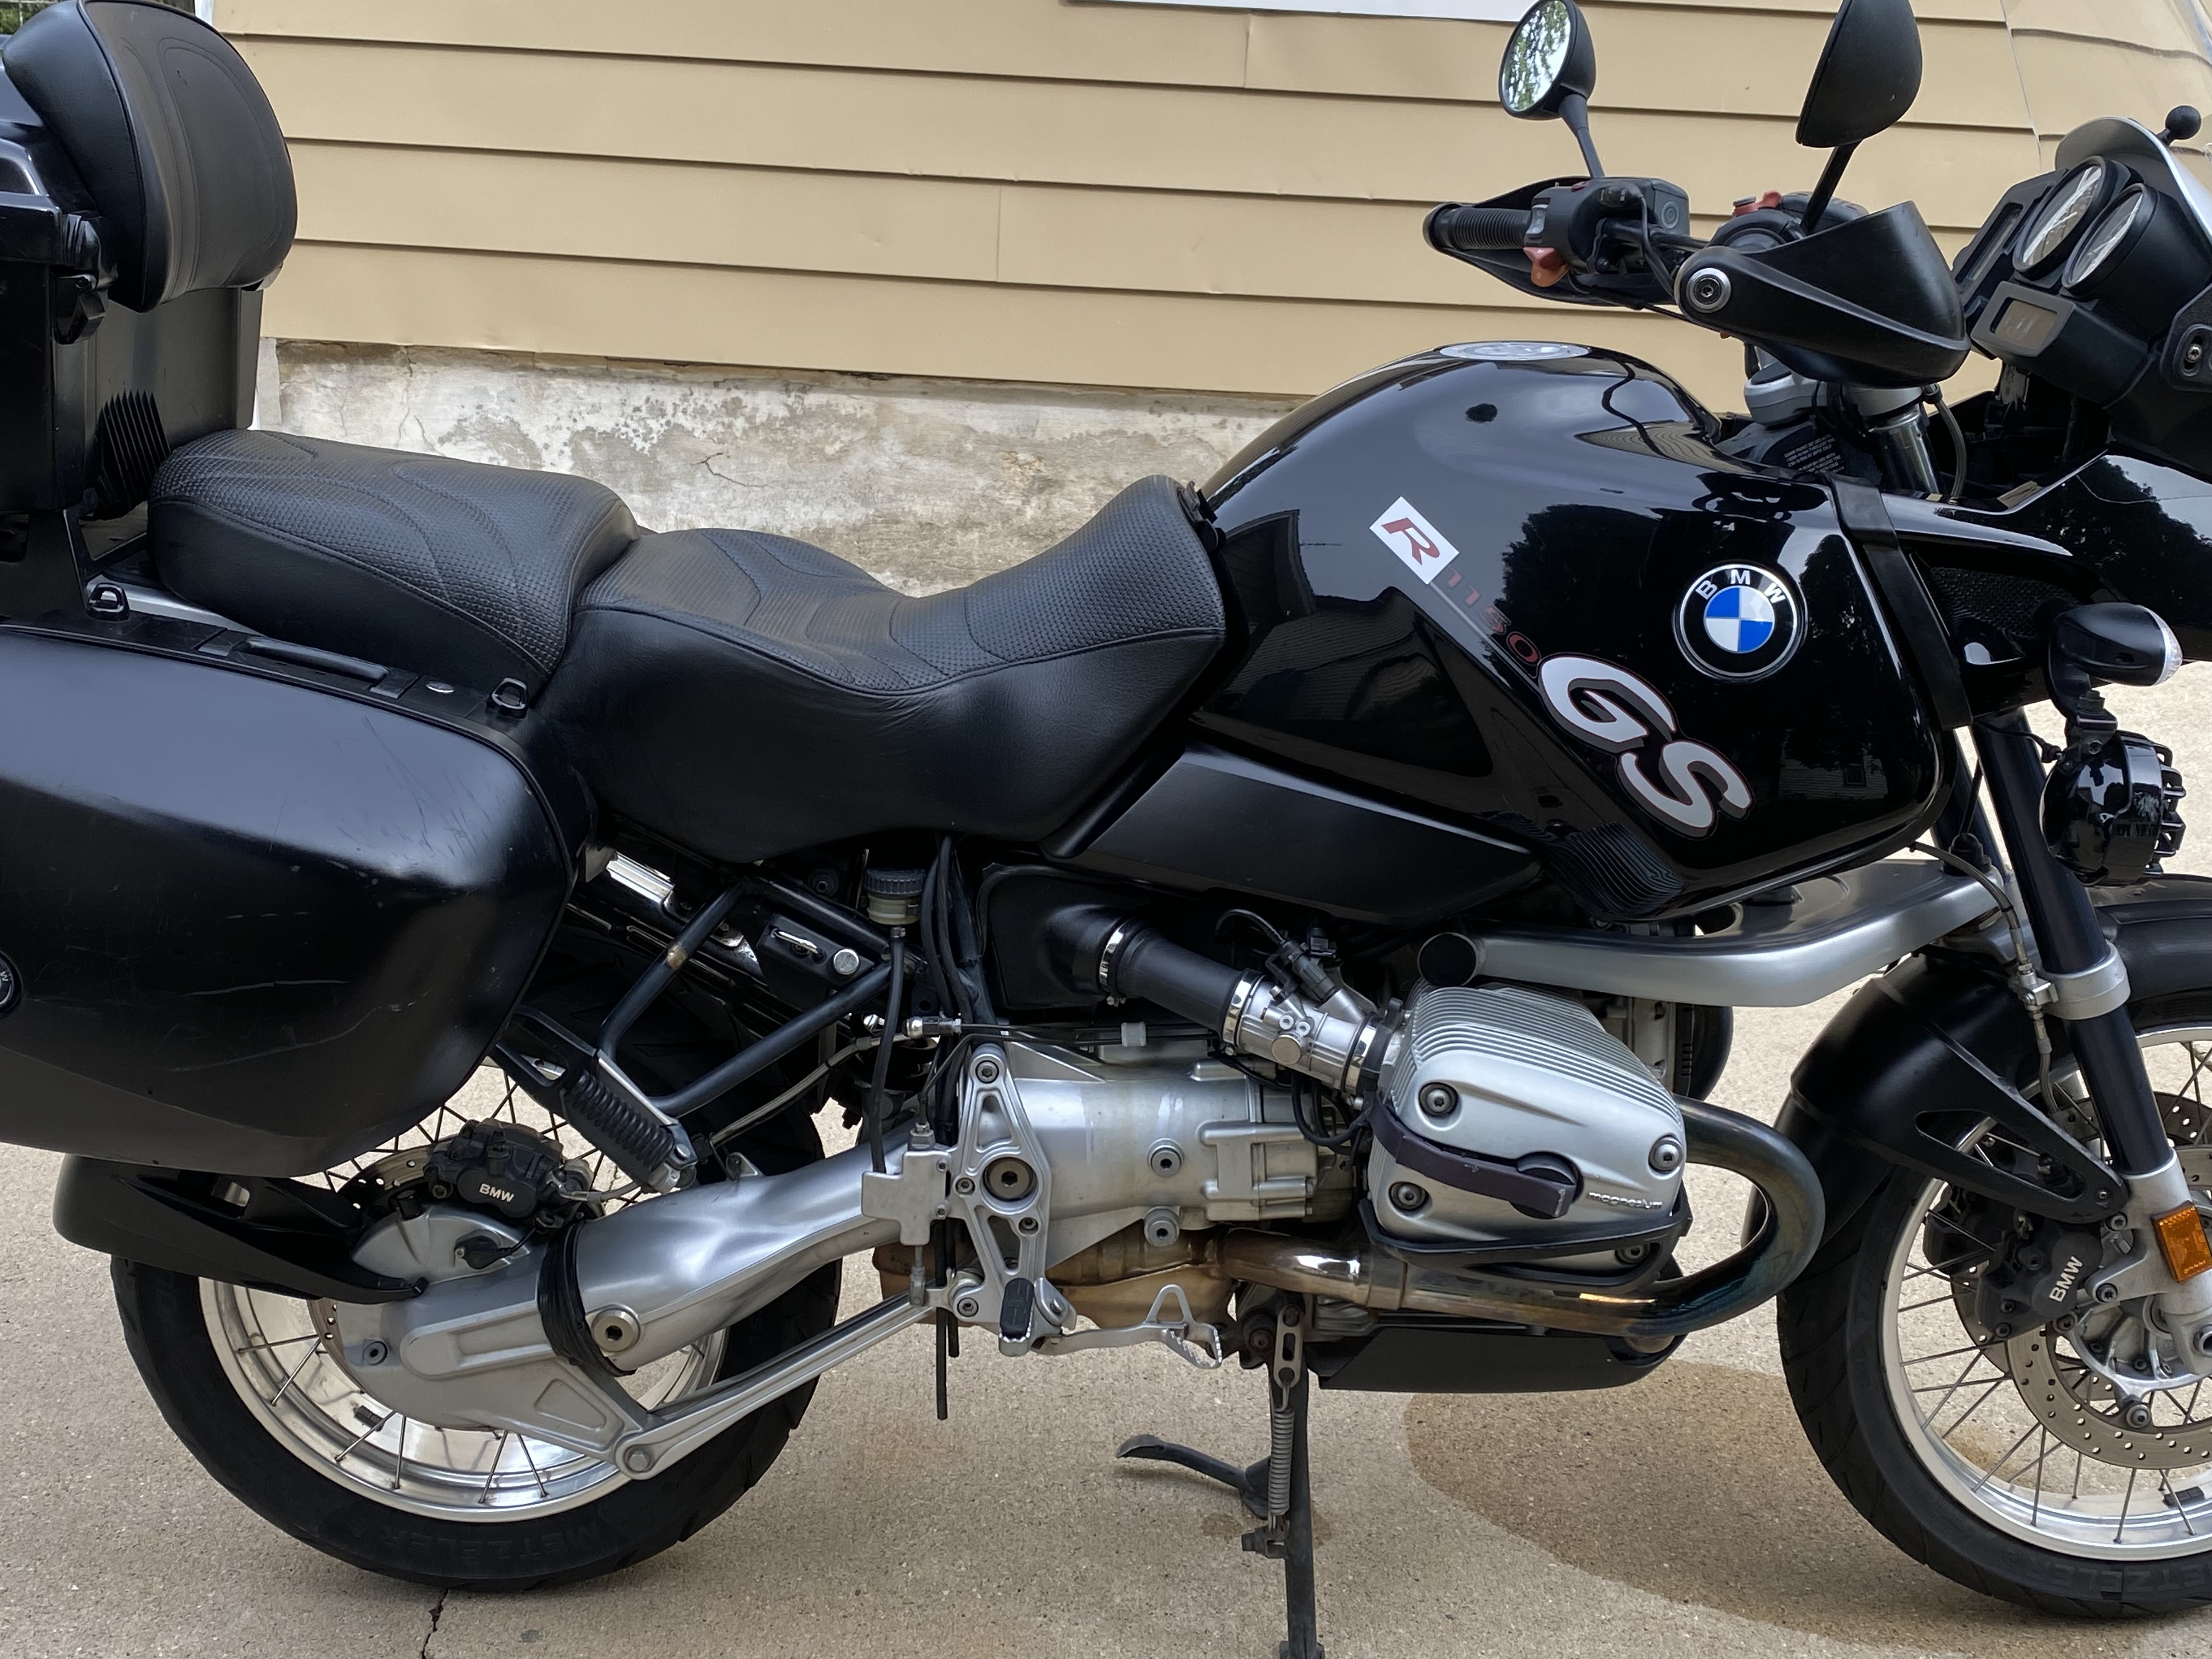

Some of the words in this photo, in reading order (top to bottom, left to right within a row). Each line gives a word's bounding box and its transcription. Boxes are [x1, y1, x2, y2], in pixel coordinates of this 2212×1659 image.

[1696, 569, 1786, 603] BMW
[1381, 517, 1441, 566] R
[1537, 653, 1754, 837] GS
[479, 1183, 515, 1203] BMW
[2049, 1256, 2083, 1302] BMW
[2024, 1558, 2212, 1592] ETZELER
